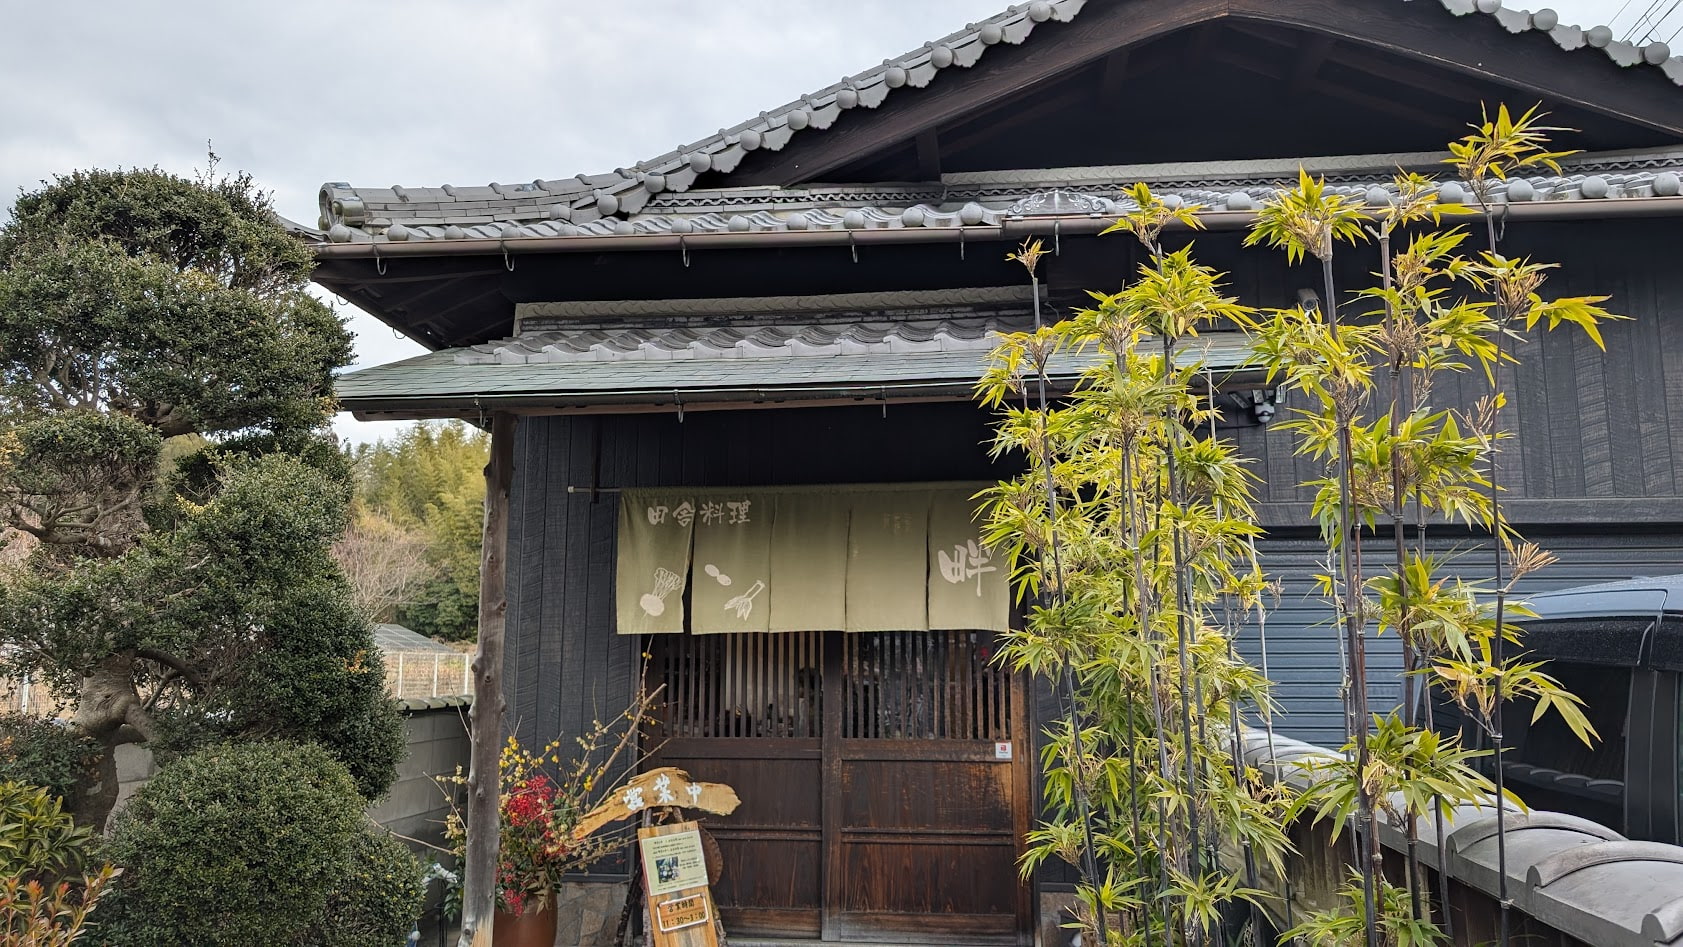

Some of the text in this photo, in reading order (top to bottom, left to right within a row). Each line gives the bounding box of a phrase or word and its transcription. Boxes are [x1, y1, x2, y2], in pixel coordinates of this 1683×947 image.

[647, 499, 752, 527] 田舎料理
[937, 539, 998, 598] 畔
[623, 773, 703, 811] 営業中
